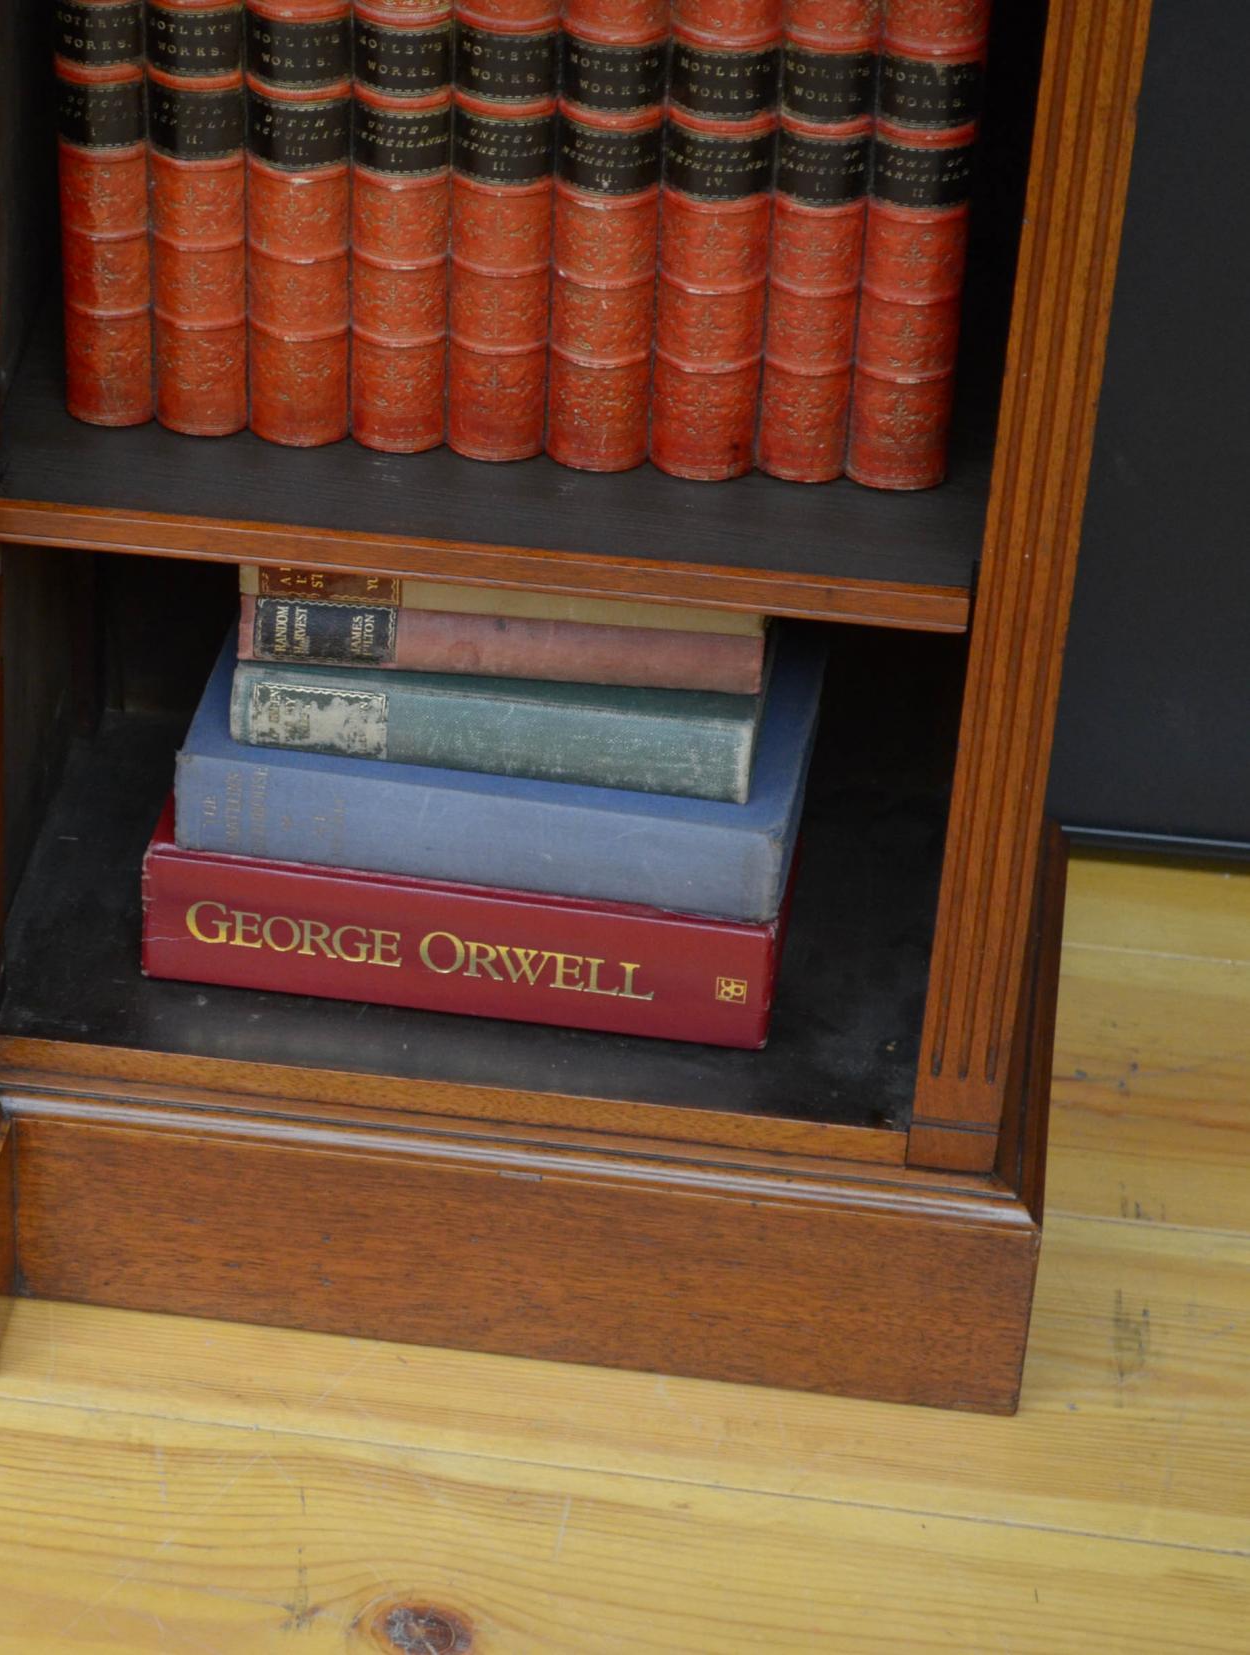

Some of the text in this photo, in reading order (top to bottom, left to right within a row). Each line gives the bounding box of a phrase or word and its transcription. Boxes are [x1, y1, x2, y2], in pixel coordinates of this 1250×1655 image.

[62, 34, 133, 52] WORKS.
[157, 41, 227, 58] WORKS.
[462, 40, 550, 62] MOTLEY'S
[367, 59, 437, 78] WORKS.
[570, 52, 659, 73] MOTLEY'S
[679, 57, 771, 78] MOTLEY'S
[785, 60, 871, 81] MOTLEY'S
[469, 66, 542, 84] WORKS.
[578, 78, 652, 96] WORKS.
[688, 82, 761, 101] WORKS.
[793, 85, 862, 103] WORKS.
[894, 94, 967, 110] WORKS.
[367, 119, 430, 135] UNITED
[274, 606, 290, 653] RANDOM
[351, 615, 364, 655] JAMES
[185, 900, 655, 1001] GEORGE ORWELL
